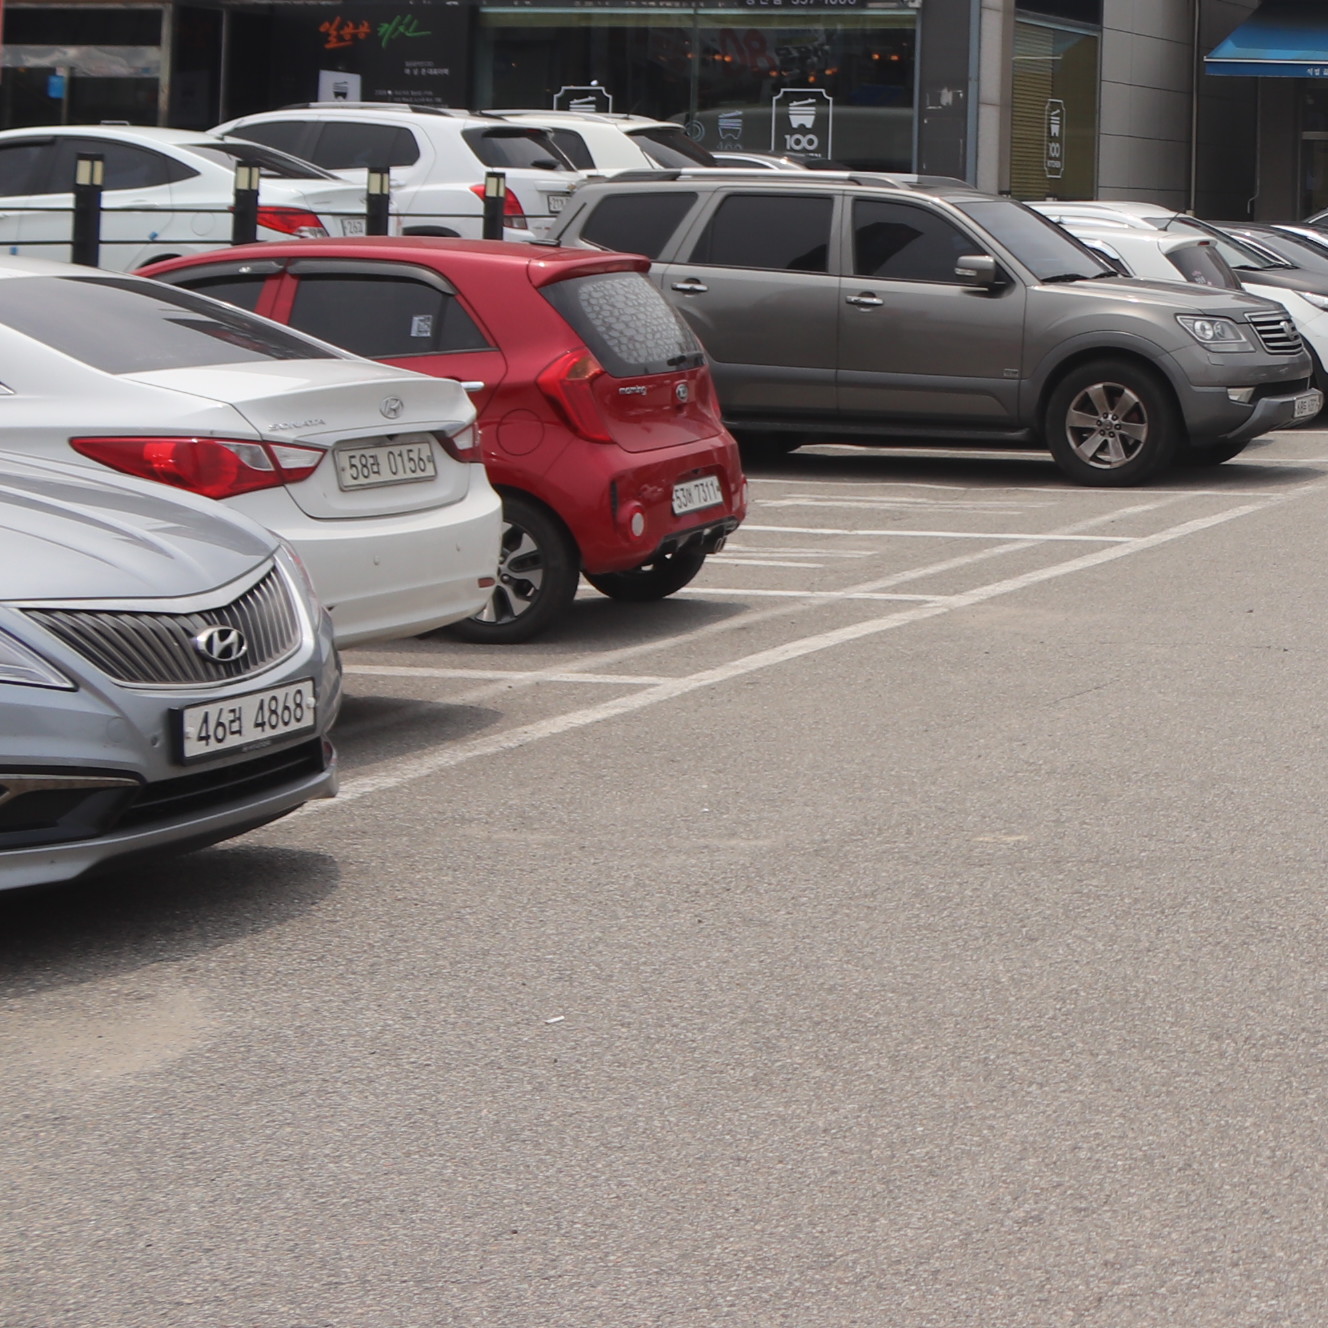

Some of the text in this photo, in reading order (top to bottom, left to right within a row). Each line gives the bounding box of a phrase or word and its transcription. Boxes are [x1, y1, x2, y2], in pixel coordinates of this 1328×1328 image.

[784, 133, 819, 151] 100
[348, 448, 426, 480] 58라 0156
[197, 689, 304, 747] 46러 4868
